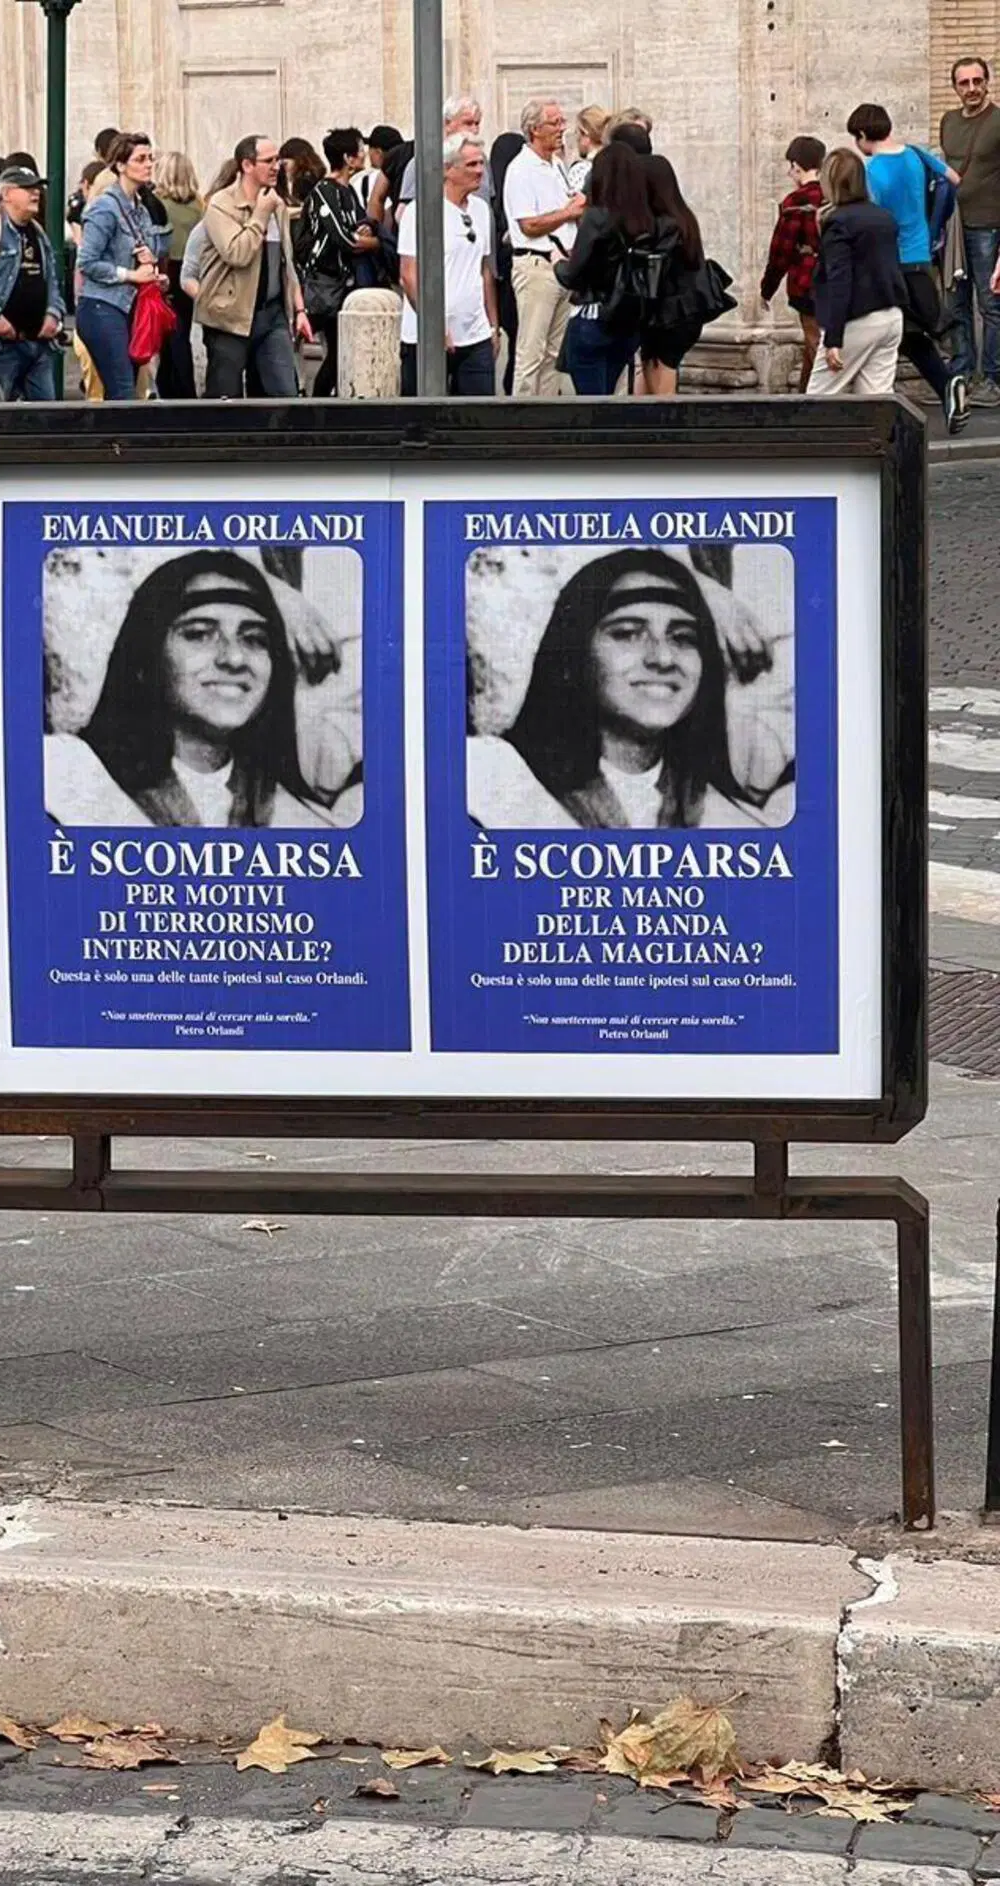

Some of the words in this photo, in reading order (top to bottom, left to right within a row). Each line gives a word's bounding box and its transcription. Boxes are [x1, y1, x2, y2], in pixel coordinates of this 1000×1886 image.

[42, 514, 216, 542] EMANUELA
[222, 514, 365, 541] ORLANDI
[464, 512, 643, 541] EMANUELA
[649, 511, 795, 539] ORLANDI
[48, 828, 76, 875] È
[90, 840, 363, 878] SCOMPARSA
[470, 832, 500, 879] È
[514, 842, 794, 879] SCOMPARSA
[125, 883, 177, 905] PER
[185, 884, 285, 906] MOTIVI
[560, 886, 613, 908] PER
[621, 885, 705, 908] MANO
[99, 910, 127, 933] DI
[134, 911, 314, 935] TERRORISMO
[536, 914, 627, 936] DELLA
[636, 914, 729, 936] BANDA
[83, 938, 332, 962] INTERNAZIONALE?
[503, 942, 593, 964] DELLA
[601, 942, 763, 965] MAGLIANA?
[49, 969, 91, 984] Questa
[94, 969, 102, 982] è
[104, 969, 129, 983] solo
[131, 973, 155, 983] una
[157, 970, 186, 984] delle
[189, 972, 220, 984] tante
[222, 971, 262, 987] ipotesi
[265, 971, 283, 984] sul
[285, 974, 313, 984] caso
[315, 972, 368, 985] Orlandi.
[470, 973, 514, 988] Questa
[516, 973, 525, 986] è
[527, 973, 552, 986] solo
[554, 976, 579, 987] una
[581, 973, 611, 987] delle
[614, 975, 646, 987] tante
[649, 974, 689, 990] ipotesi
[692, 974, 710, 987] sul
[713, 977, 741, 987] caso
[743, 973, 797, 987] Orlandi.
[175, 1025, 205, 1035] Pietro
[206, 1025, 244, 1036] Orlandi
[599, 1029, 629, 1039] Pietro
[630, 1029, 669, 1039] Orlandi
